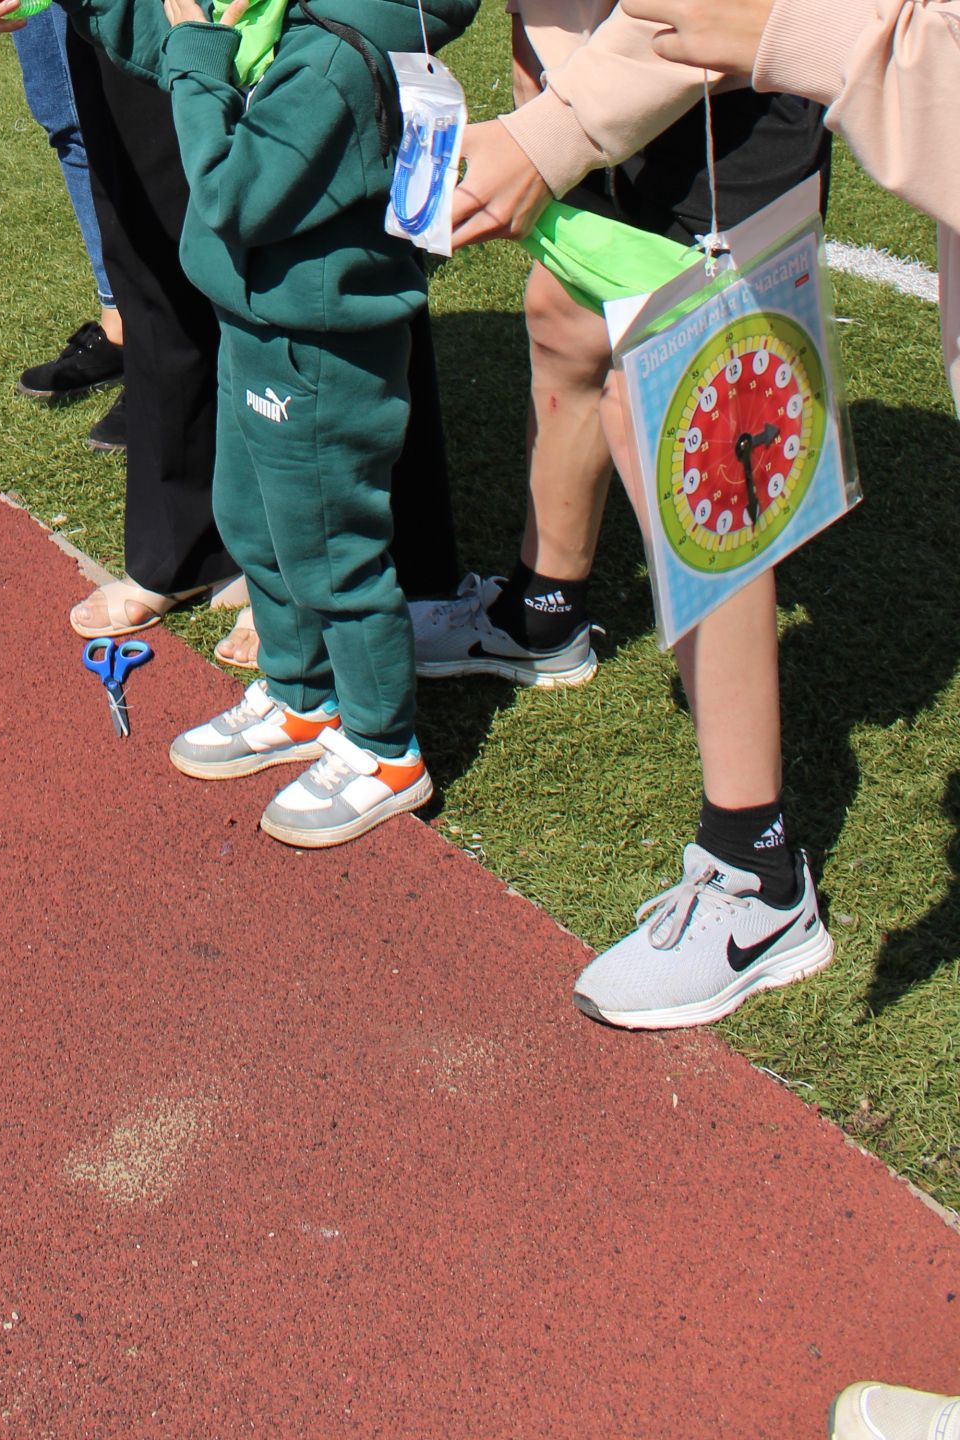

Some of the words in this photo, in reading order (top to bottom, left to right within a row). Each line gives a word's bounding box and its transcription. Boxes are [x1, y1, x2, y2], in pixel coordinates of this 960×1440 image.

[729, 364, 738, 377] 12
[246, 389, 281, 423] PUMA
[704, 393, 712, 406] 11
[688, 434, 698, 448] 10
